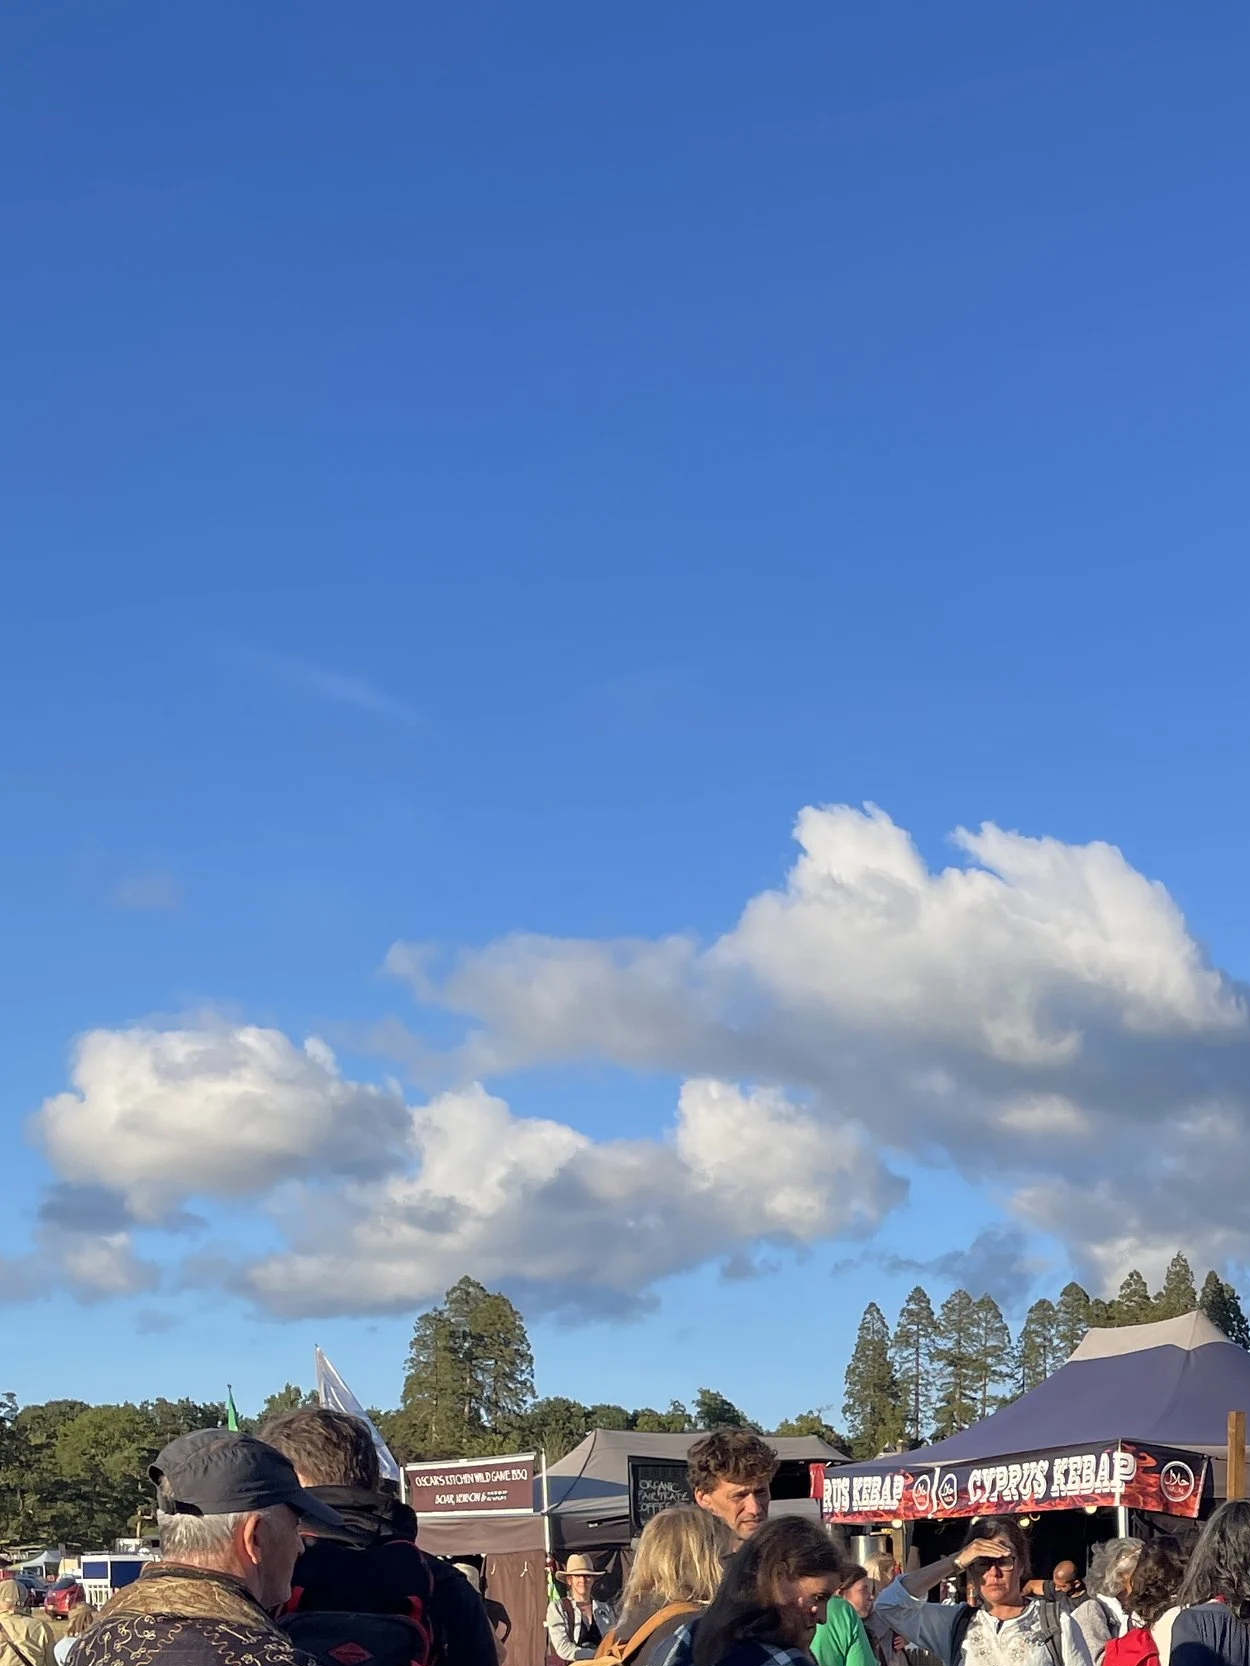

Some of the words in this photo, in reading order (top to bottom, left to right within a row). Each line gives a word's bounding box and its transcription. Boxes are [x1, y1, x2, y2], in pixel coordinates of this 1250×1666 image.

[852, 1475, 905, 1511] KEBAP
[967, 1459, 1049, 1505] CYPRUS
[1050, 1450, 1137, 1496] KEBAP
